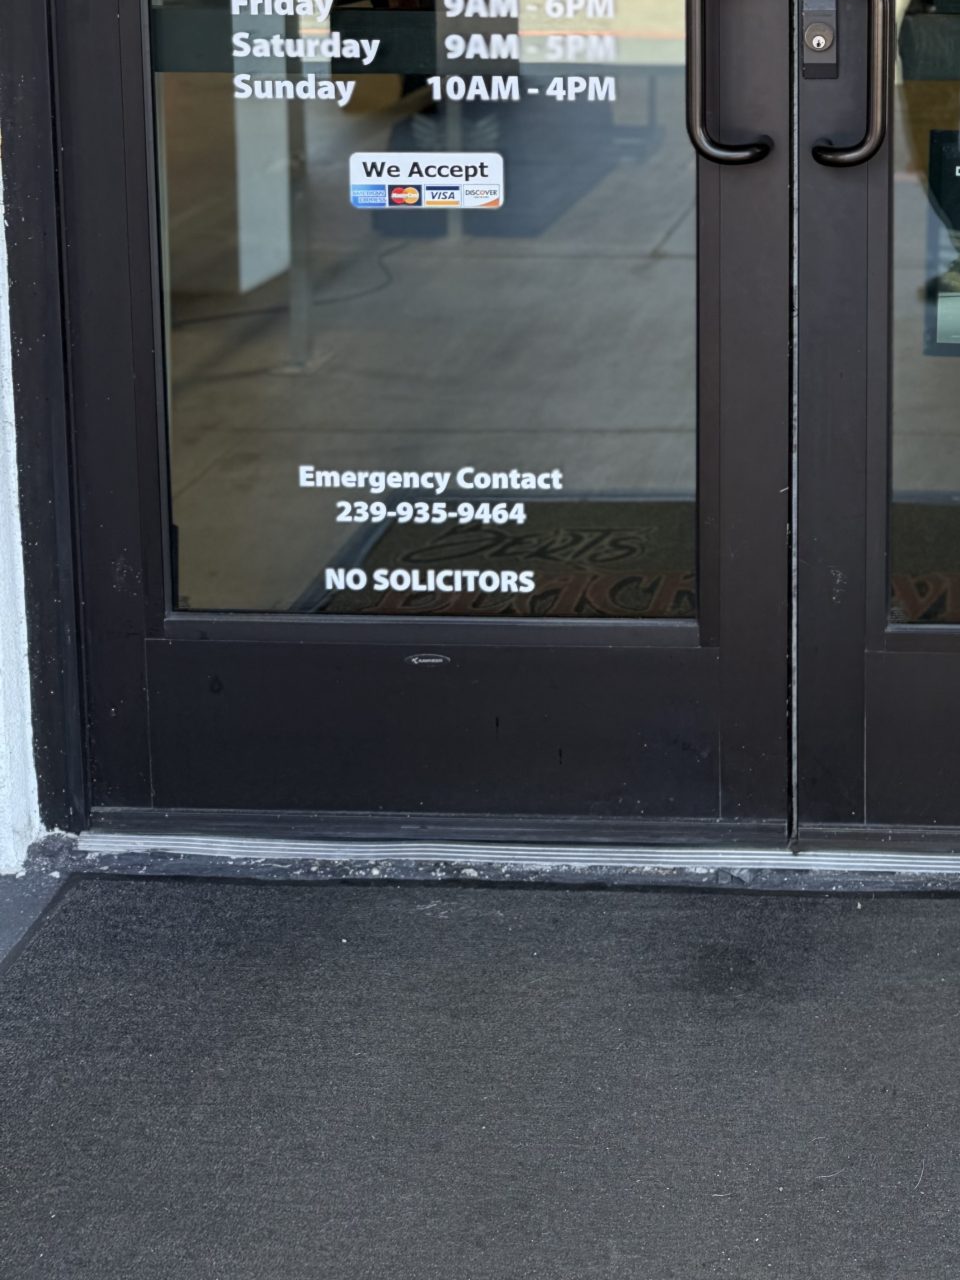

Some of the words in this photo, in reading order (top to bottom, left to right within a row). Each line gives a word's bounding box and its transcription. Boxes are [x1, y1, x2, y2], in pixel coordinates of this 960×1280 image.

[231, 32, 380, 65] Saturday
[444, 34, 520, 61] 9AM
[543, 35, 617, 62] 5PM
[233, 73, 356, 107] Sunday
[427, 76, 520, 101] 10AM
[545, 77, 617, 102] 4PM
[362, 161, 400, 178] We
[407, 161, 489, 182] Accept
[431, 191, 456, 200] VISA
[299, 466, 450, 493] Emergency
[456, 468, 563, 489] Contact
[336, 502, 526, 524] 239-935-9464
[325, 569, 367, 590] NO
[374, 570, 536, 593] SOLICITORS
